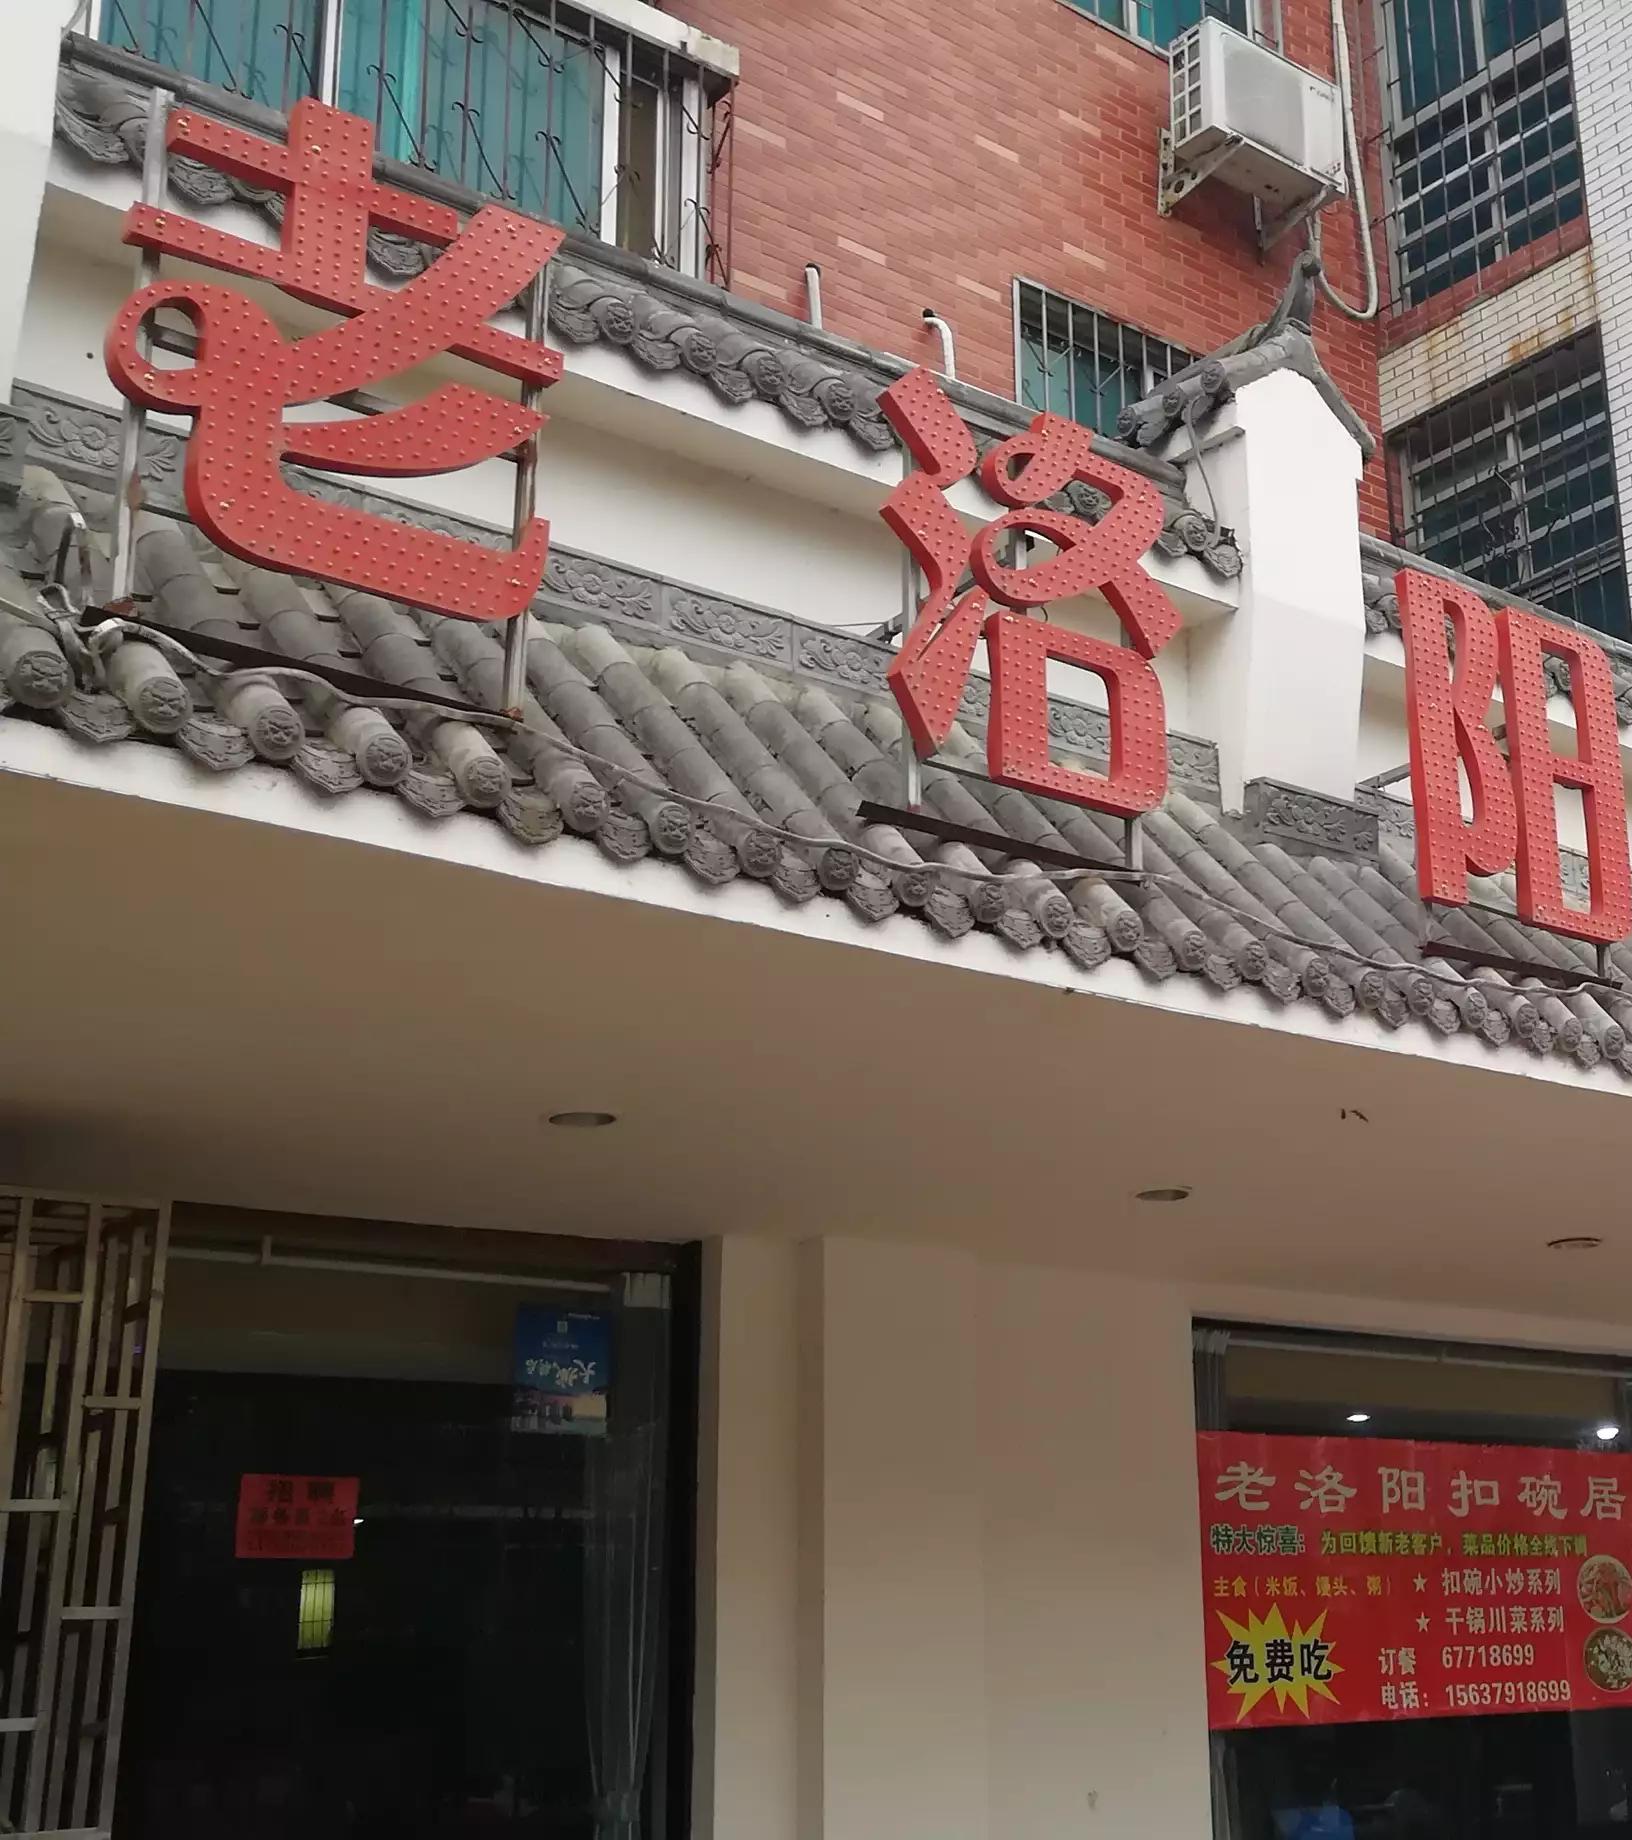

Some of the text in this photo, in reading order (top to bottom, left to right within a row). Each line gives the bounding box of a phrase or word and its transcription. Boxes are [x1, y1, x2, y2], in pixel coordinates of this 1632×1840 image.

[1214, 1461, 1626, 1520] 老洛阳扣碗居
[1441, 1567, 1562, 1596] 扣碗小炒系列
[1445, 1605, 1565, 1635] 干锅川菜系列
[1225, 1638, 1334, 1687] 免费吃
[1379, 1644, 1535, 1675] 订餐 67718699
[1445, 1679, 1571, 1708] 15637918699
